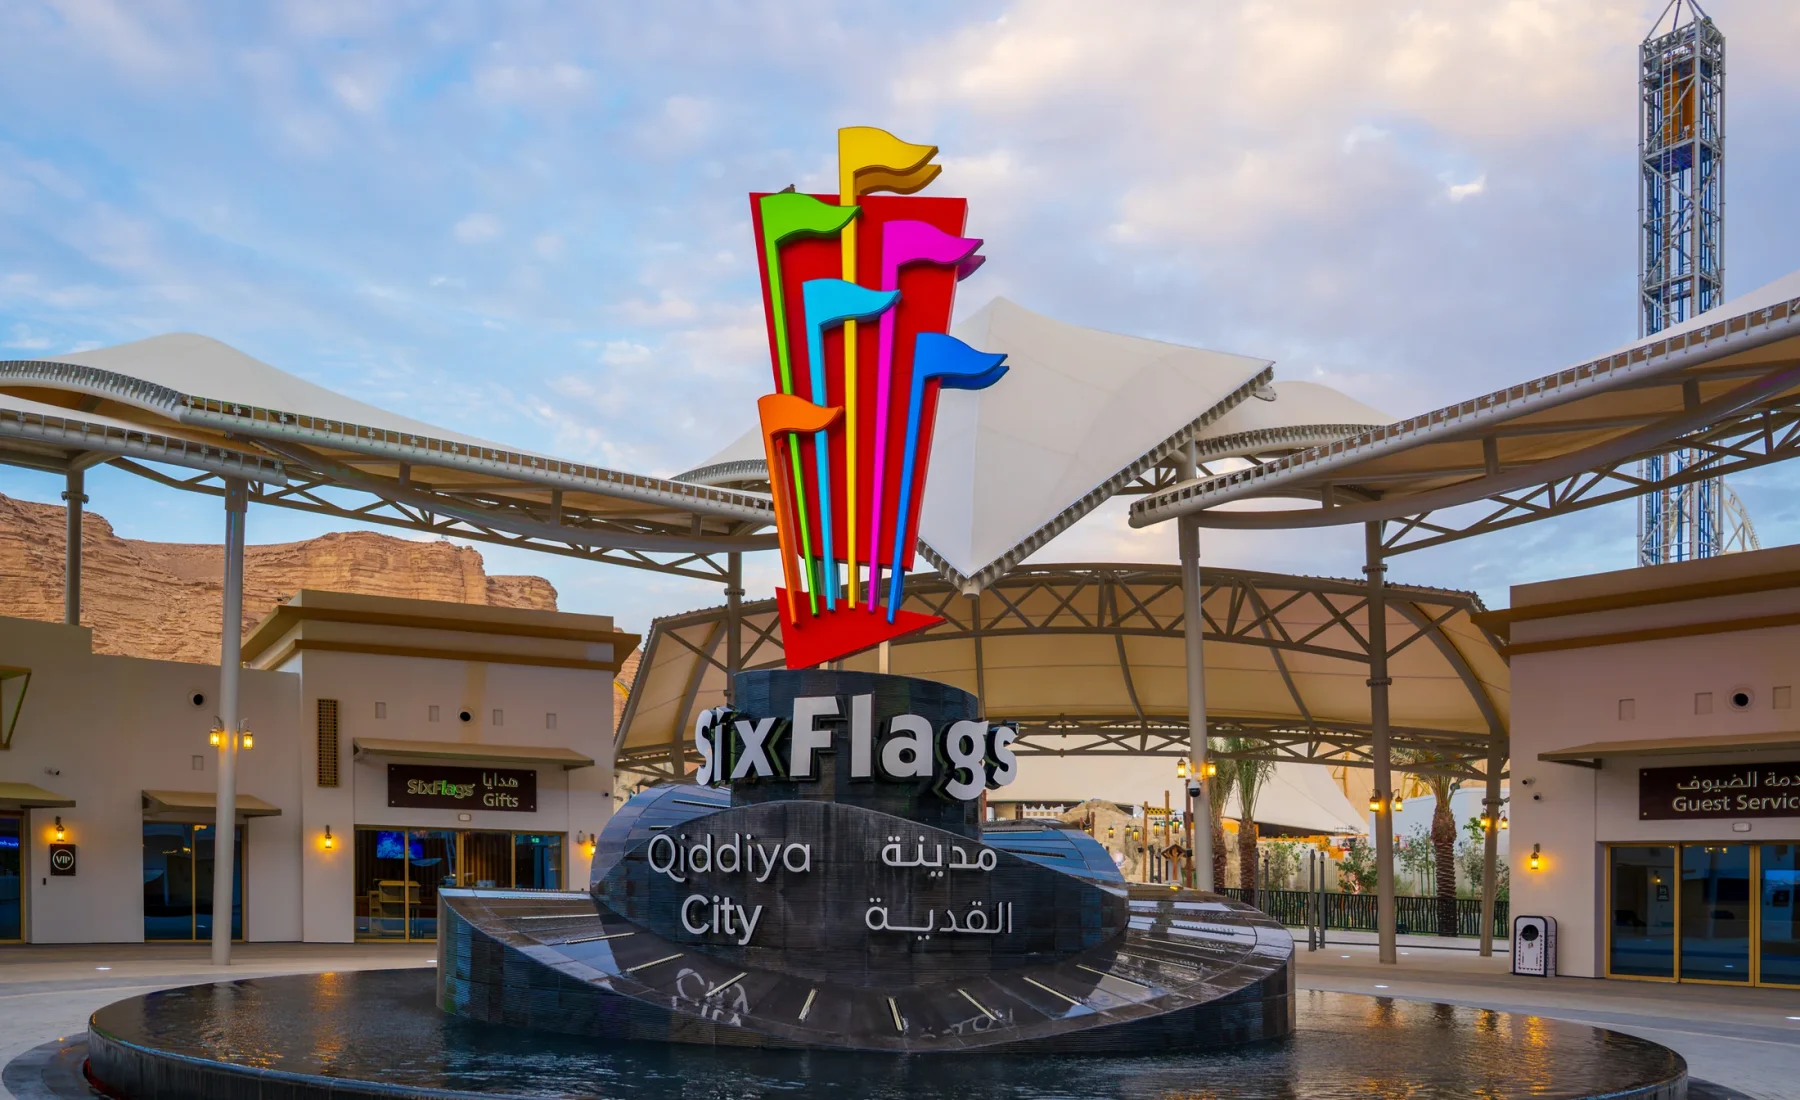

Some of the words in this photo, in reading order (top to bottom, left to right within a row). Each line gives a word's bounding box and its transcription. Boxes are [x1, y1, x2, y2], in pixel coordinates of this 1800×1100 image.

[482, 772, 519, 790] هدايا
[1676, 771, 1758, 793] الضيوف
[1764, 771, 1800, 787] دمة
[483, 793, 519, 808] Gifts
[1672, 796, 1731, 812] Guest
[1736, 793, 1800, 811] Servic
[56, 855, 71, 864] VIP
[648, 833, 811, 883] Qiddiya
[881, 835, 998, 877] مدينة
[681, 894, 763, 946] City
[865, 897, 1012, 941] القدية
